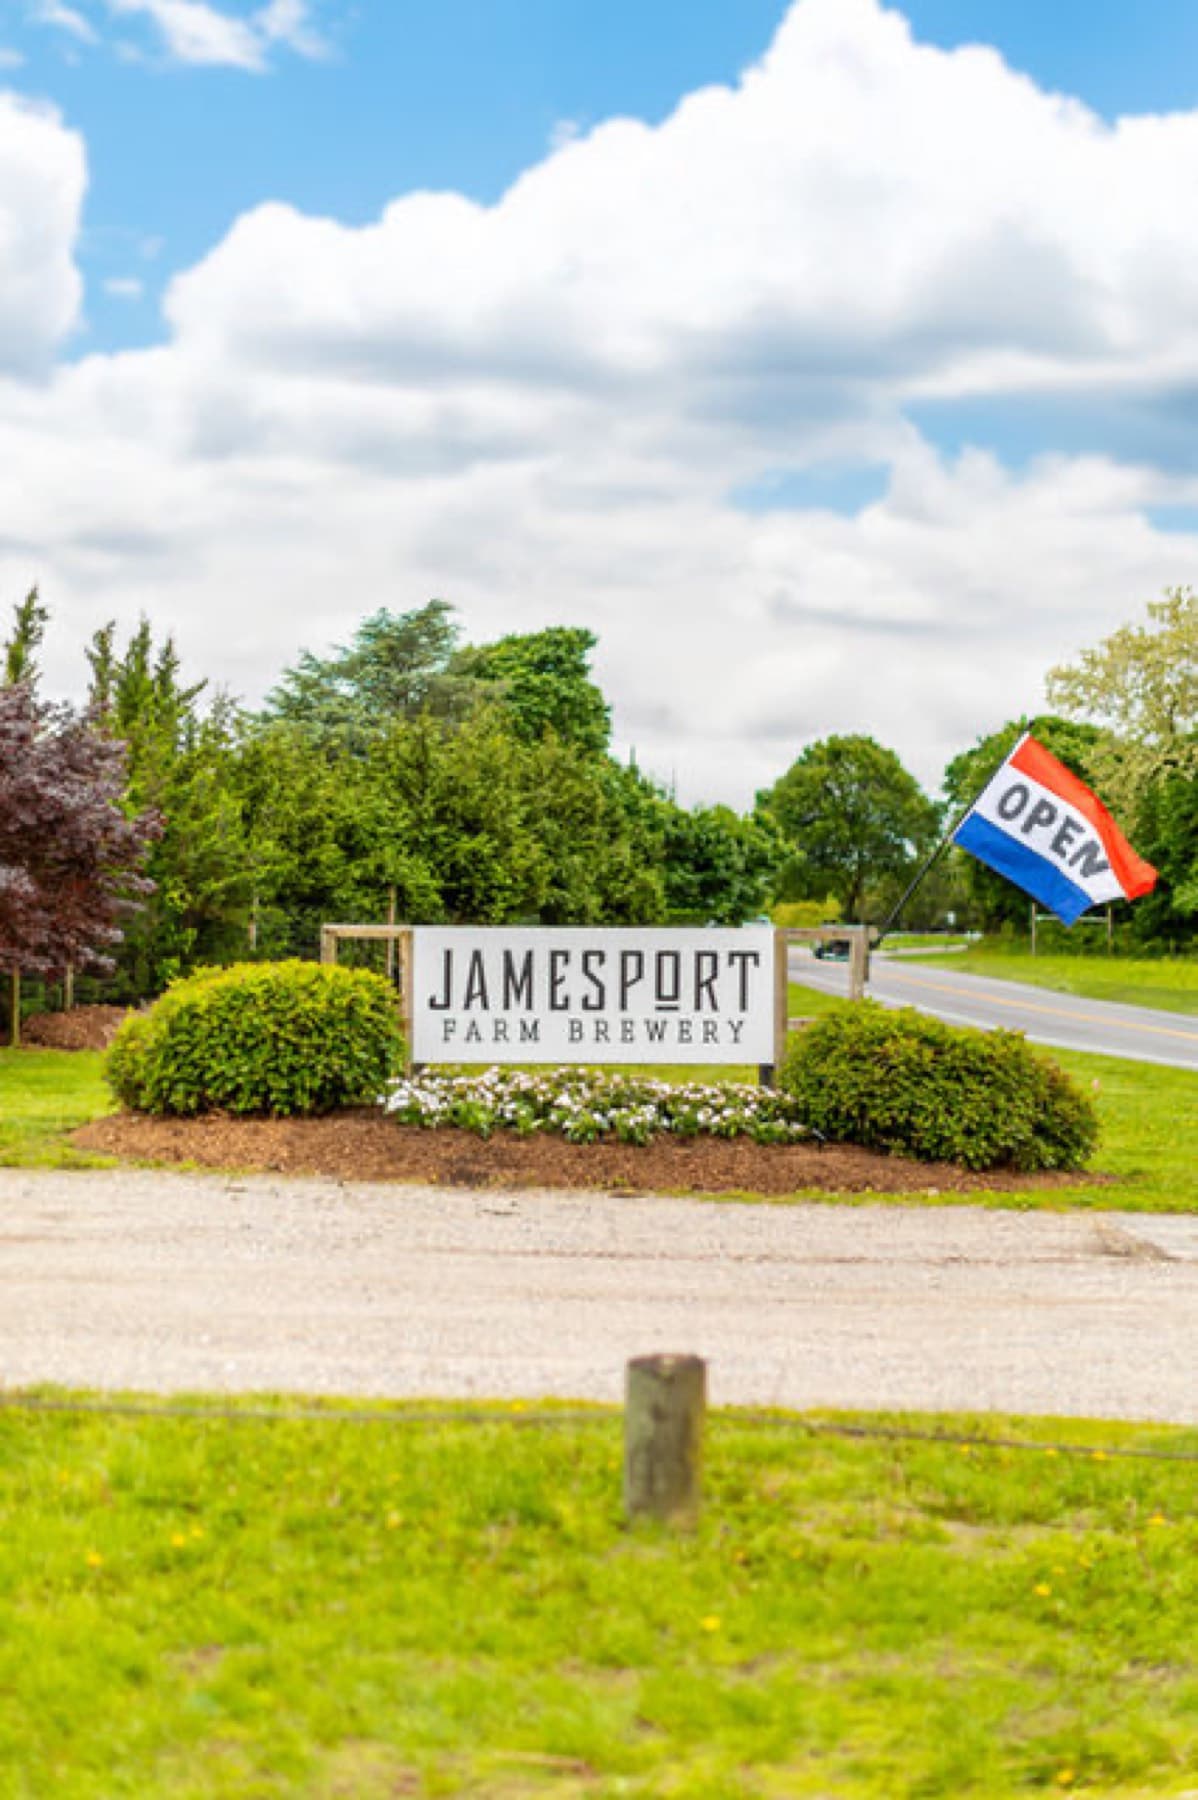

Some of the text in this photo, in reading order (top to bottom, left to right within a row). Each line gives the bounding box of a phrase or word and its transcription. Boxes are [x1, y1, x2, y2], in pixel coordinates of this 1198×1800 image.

[997, 782, 1111, 878] OPEN
[428, 948, 760, 1012] JAMESPORT
[442, 1018, 745, 1044] FARM BREWERY
